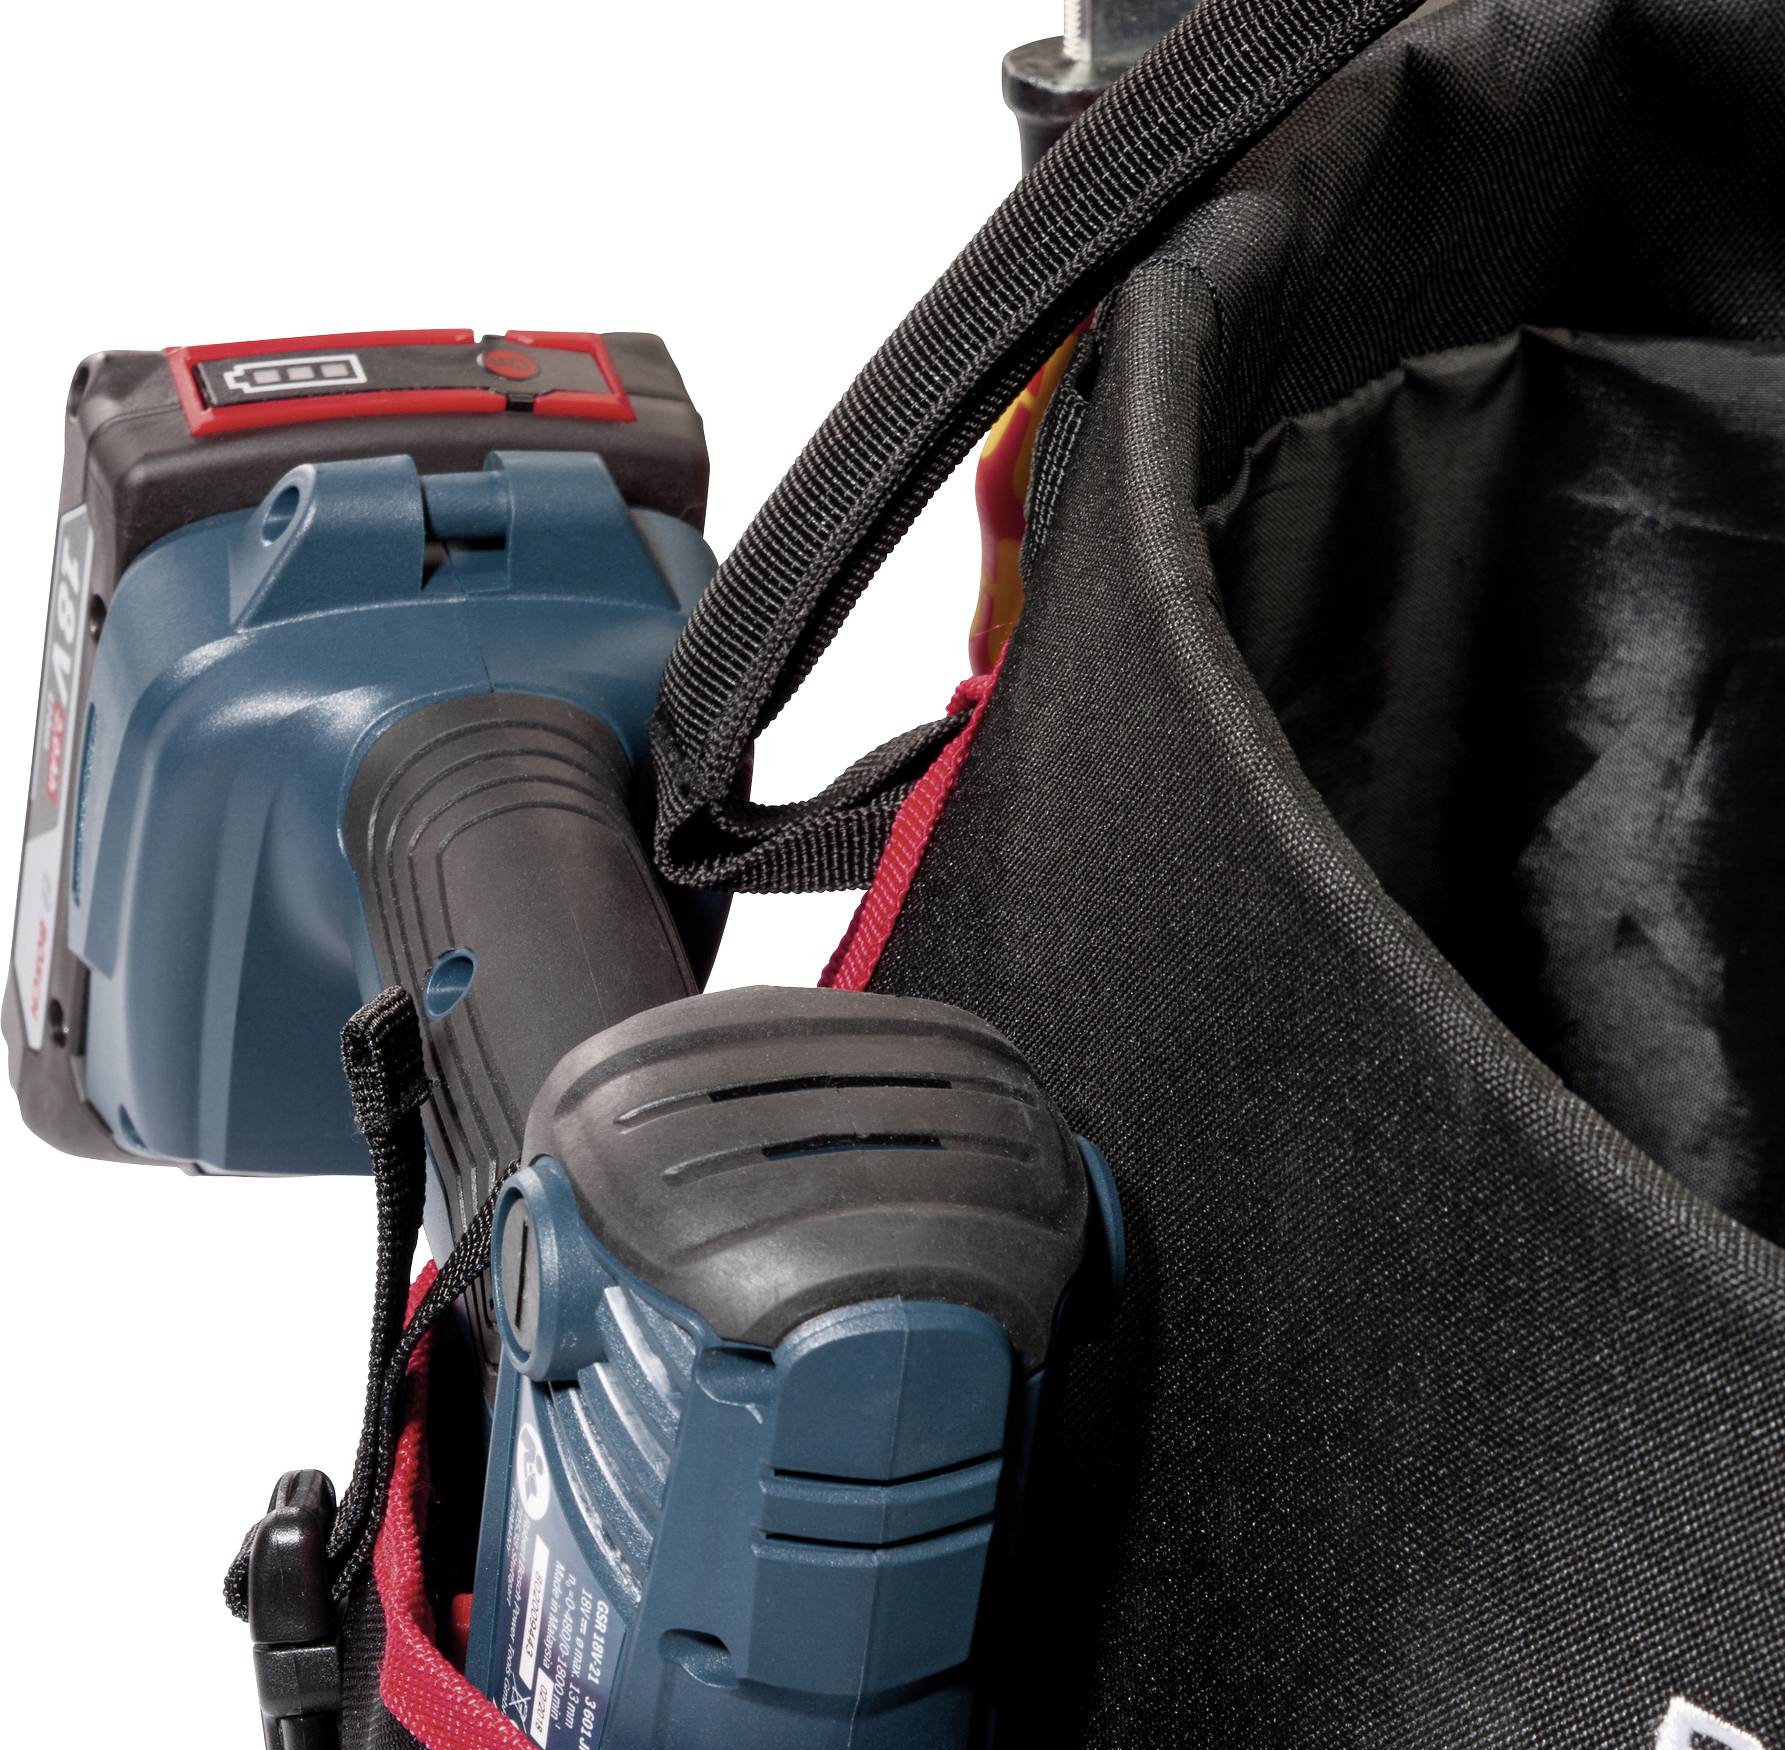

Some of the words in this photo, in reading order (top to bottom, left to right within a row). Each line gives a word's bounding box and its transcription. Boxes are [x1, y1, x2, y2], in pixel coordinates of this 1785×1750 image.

[51, 536, 80, 708] 18V
[514, 1559, 526, 1602] Bosch
[552, 1560, 566, 1598] Made
[551, 1599, 561, 1614] in
[580, 1587, 593, 1620] 18V
[594, 1600, 609, 1634] GSR
[509, 1601, 520, 1643] Power
[543, 1613, 559, 1669] Malaysia
[505, 1644, 515, 1677] Tools
[571, 1649, 584, 1680] max.
[569, 1683, 581, 1704] 13
[565, 1703, 577, 1729] mm
